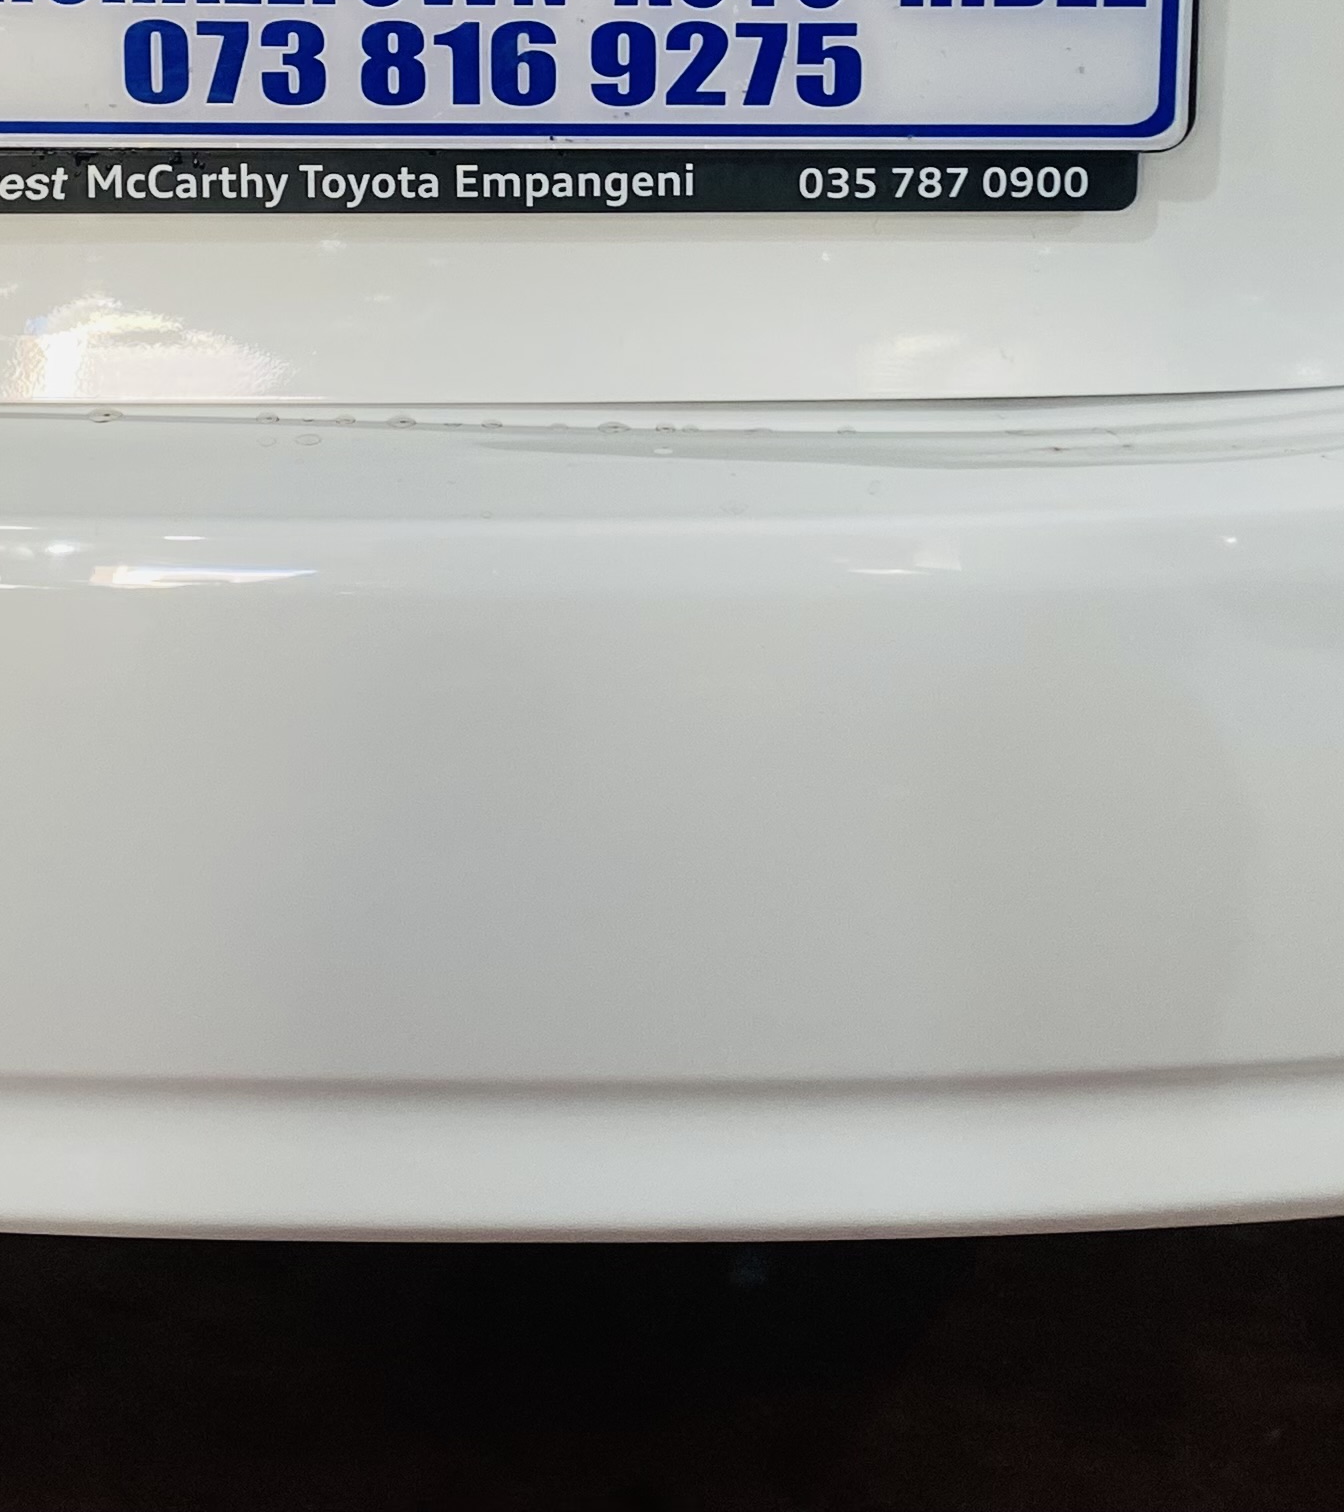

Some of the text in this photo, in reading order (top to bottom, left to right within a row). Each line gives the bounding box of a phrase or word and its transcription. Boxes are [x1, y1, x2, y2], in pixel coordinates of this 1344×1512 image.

[123, 19, 863, 107] 073 816 9275
[87, 165, 288, 208] McCarthy
[299, 165, 439, 208] Toyota
[456, 164, 694, 207] Empangeni
[799, 167, 876, 199] 035
[891, 166, 969, 199] 787
[982, 166, 1088, 199] 0900
